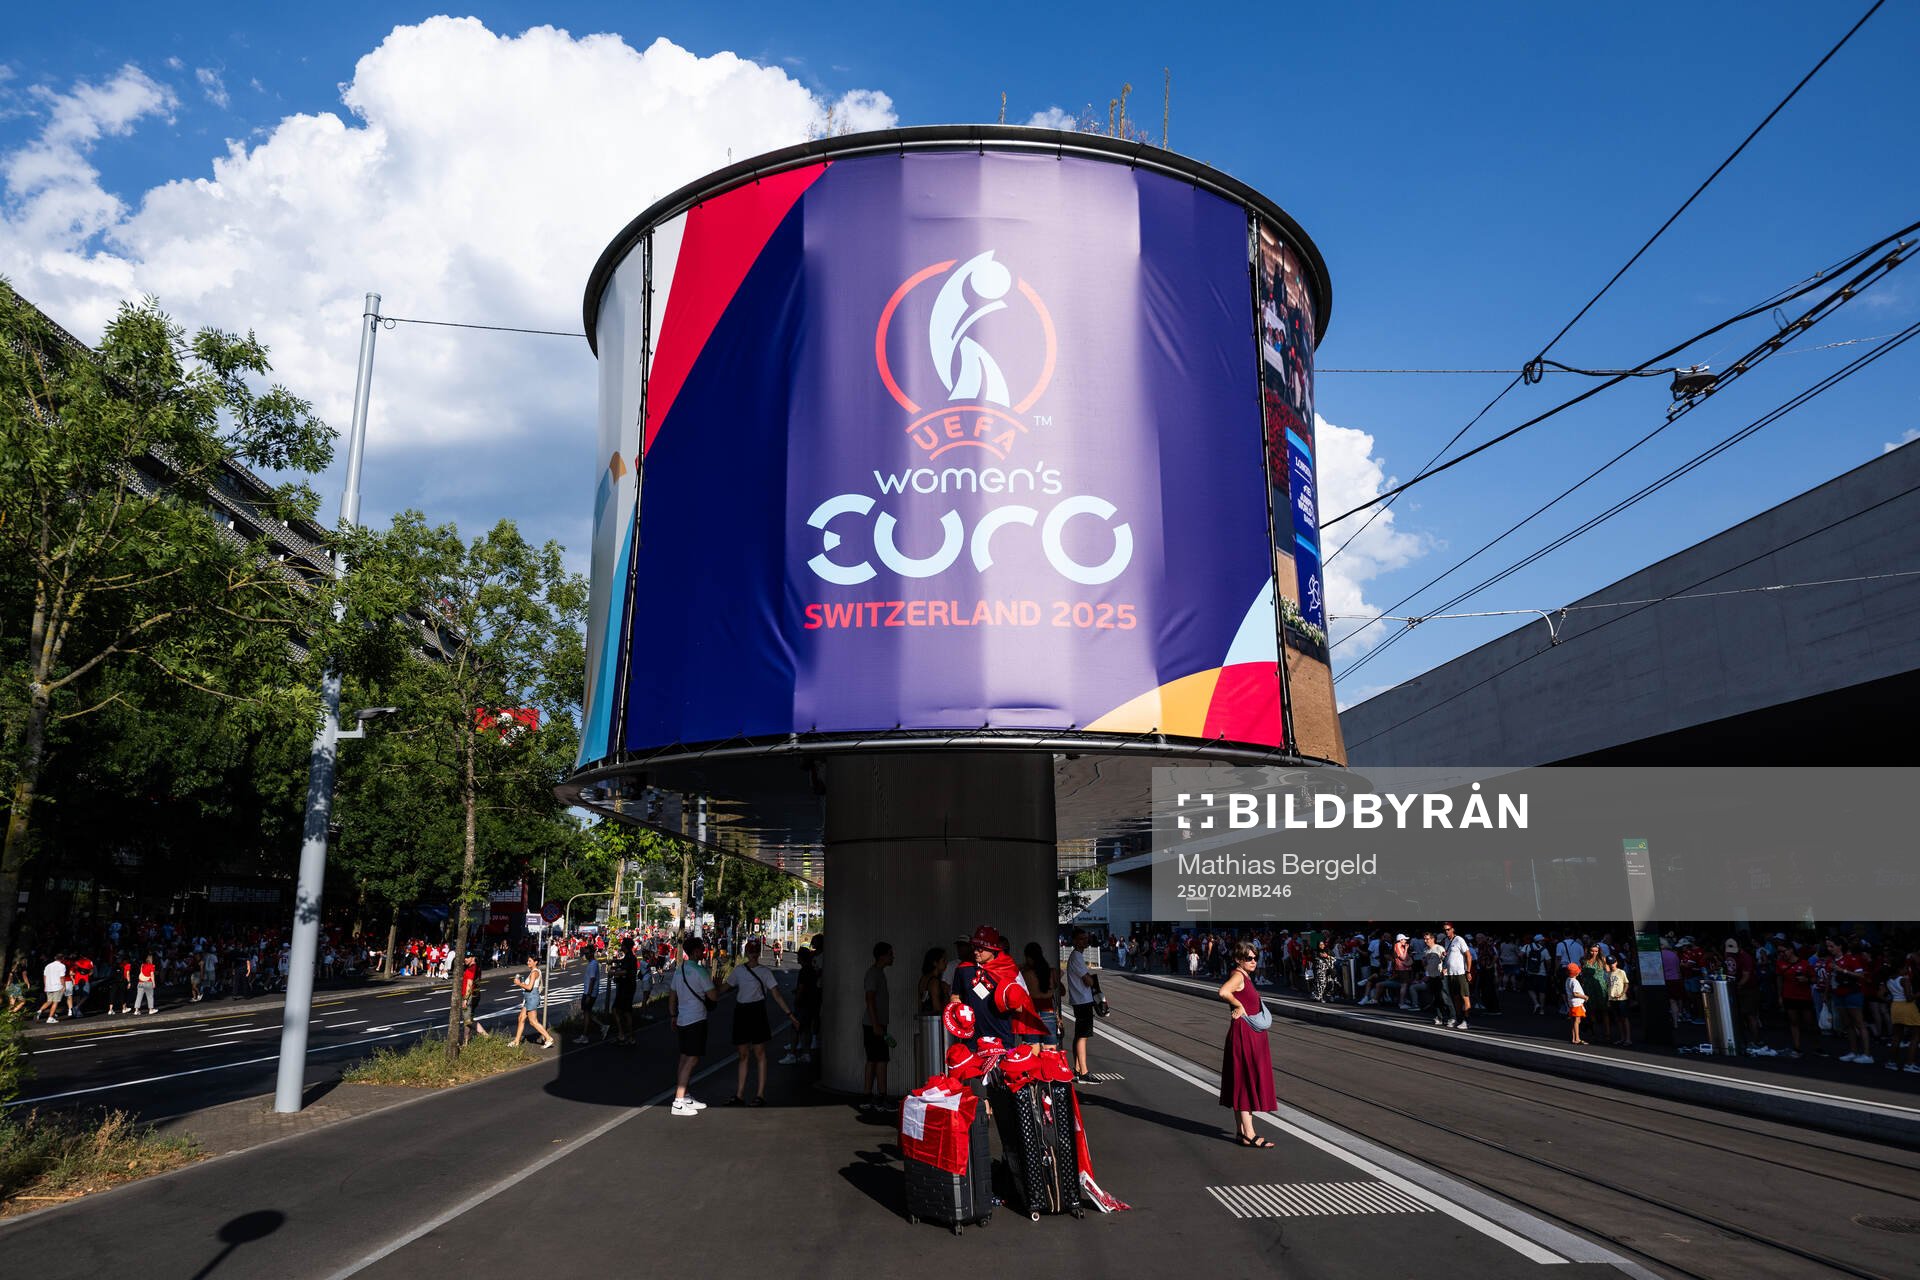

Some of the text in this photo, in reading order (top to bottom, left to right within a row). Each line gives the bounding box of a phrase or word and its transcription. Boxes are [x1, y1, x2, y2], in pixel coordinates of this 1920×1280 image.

[913, 415, 1016, 453] UEFA
[1033, 415, 1052, 426] TM
[873, 460, 1063, 494] women's
[803, 600, 1137, 630] SWITZERLAND 2025
